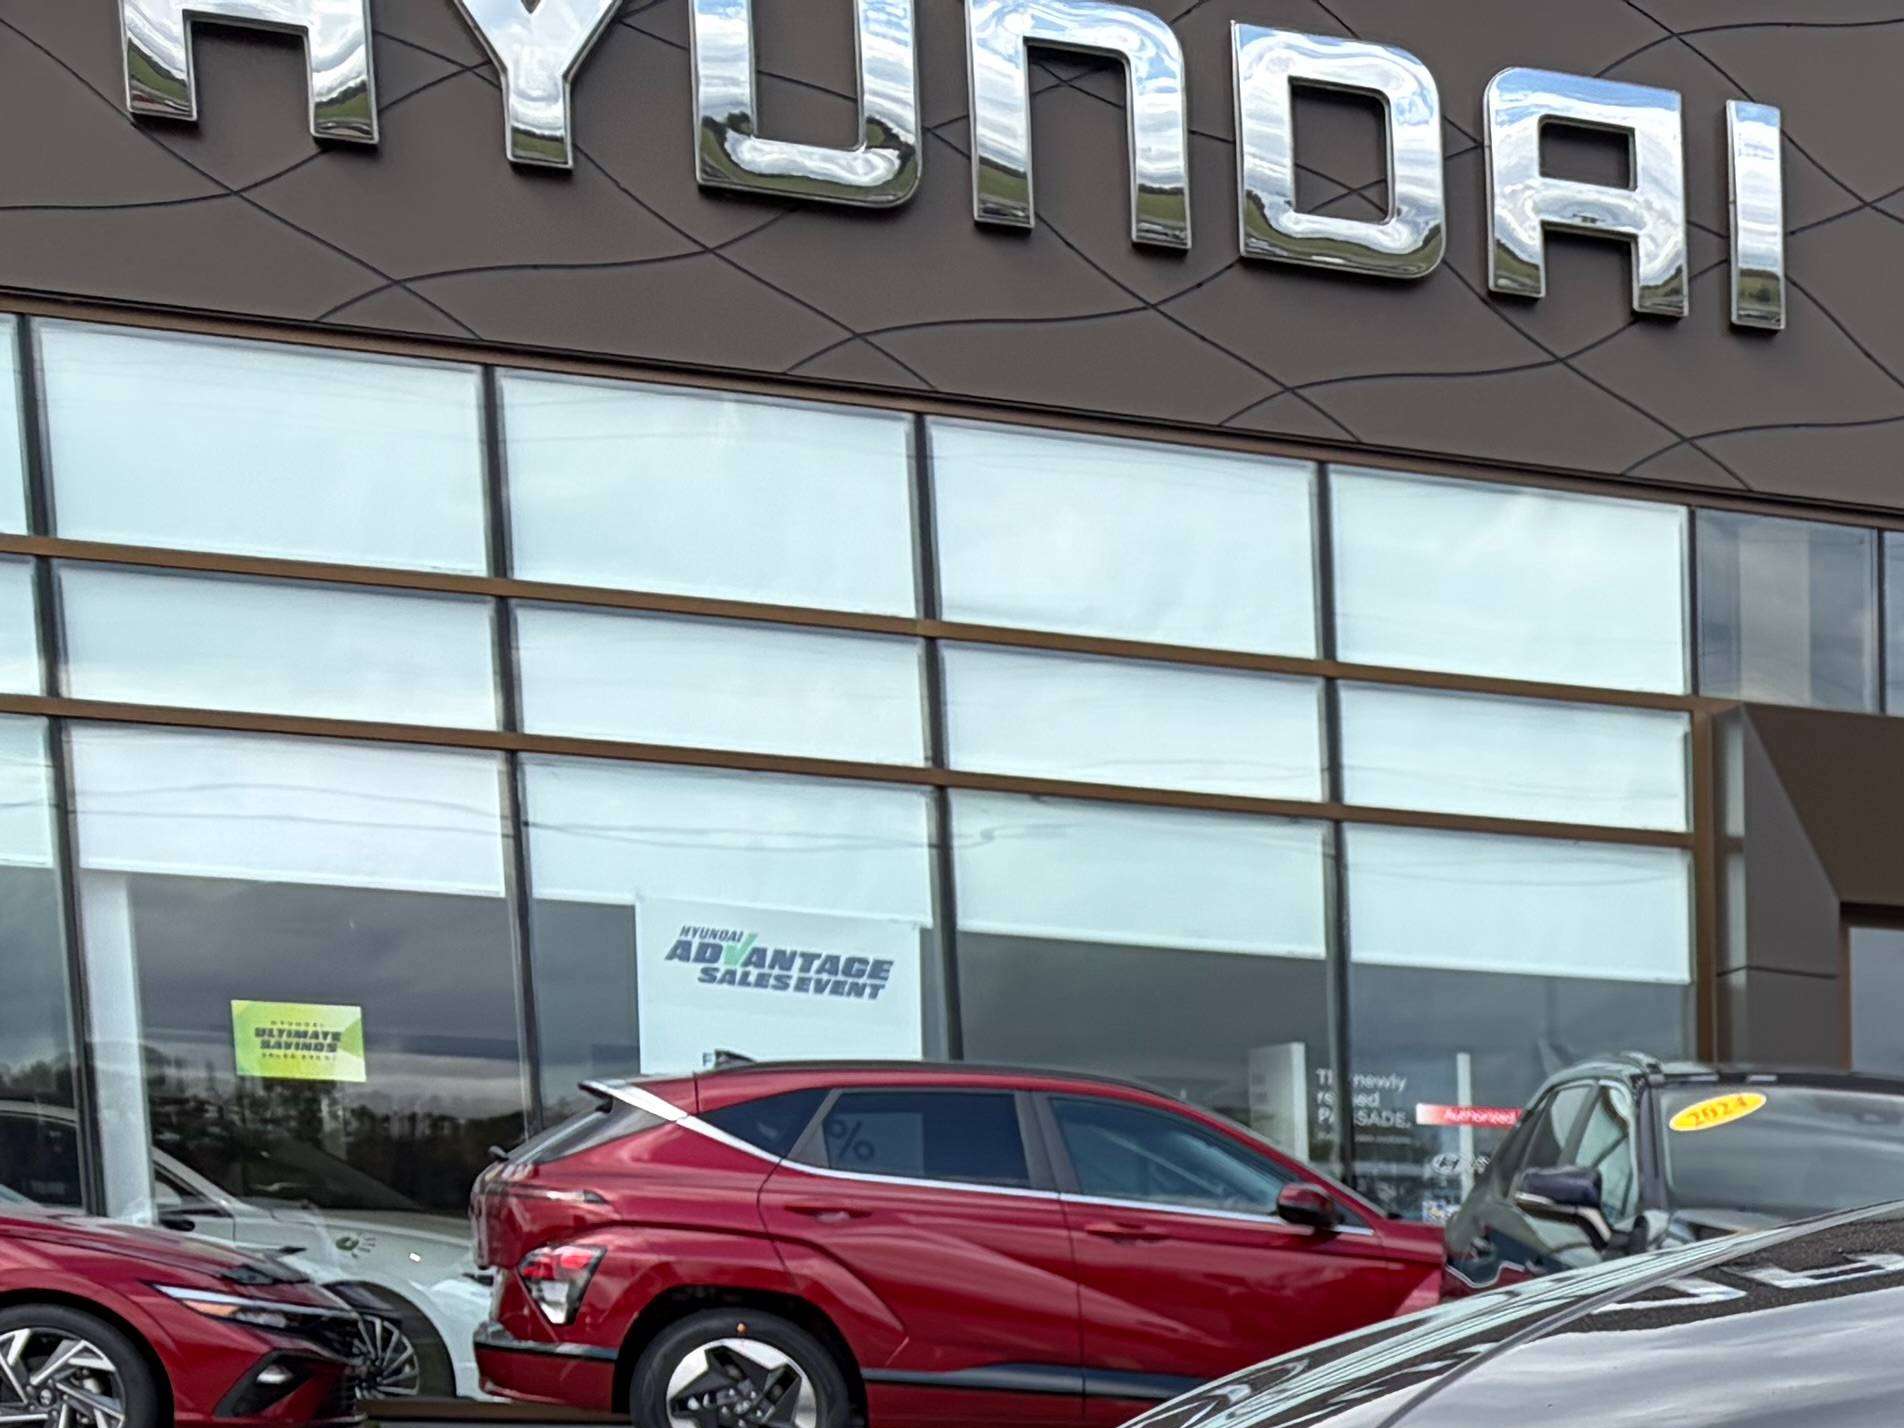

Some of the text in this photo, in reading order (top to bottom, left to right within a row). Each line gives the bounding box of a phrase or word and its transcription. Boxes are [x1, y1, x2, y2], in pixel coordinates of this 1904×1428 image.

[680, 924, 744, 943] HYUNDAI
[664, 933, 894, 981] ADVANTAGE
[697, 967, 886, 1000] SALES EVENT
[255, 1027, 342, 1043] ULTIMATE
[260, 1039, 337, 1053] SAVINGS
[1353, 1073, 1407, 1093] newly
[1444, 1108, 1517, 1125] Authorized
